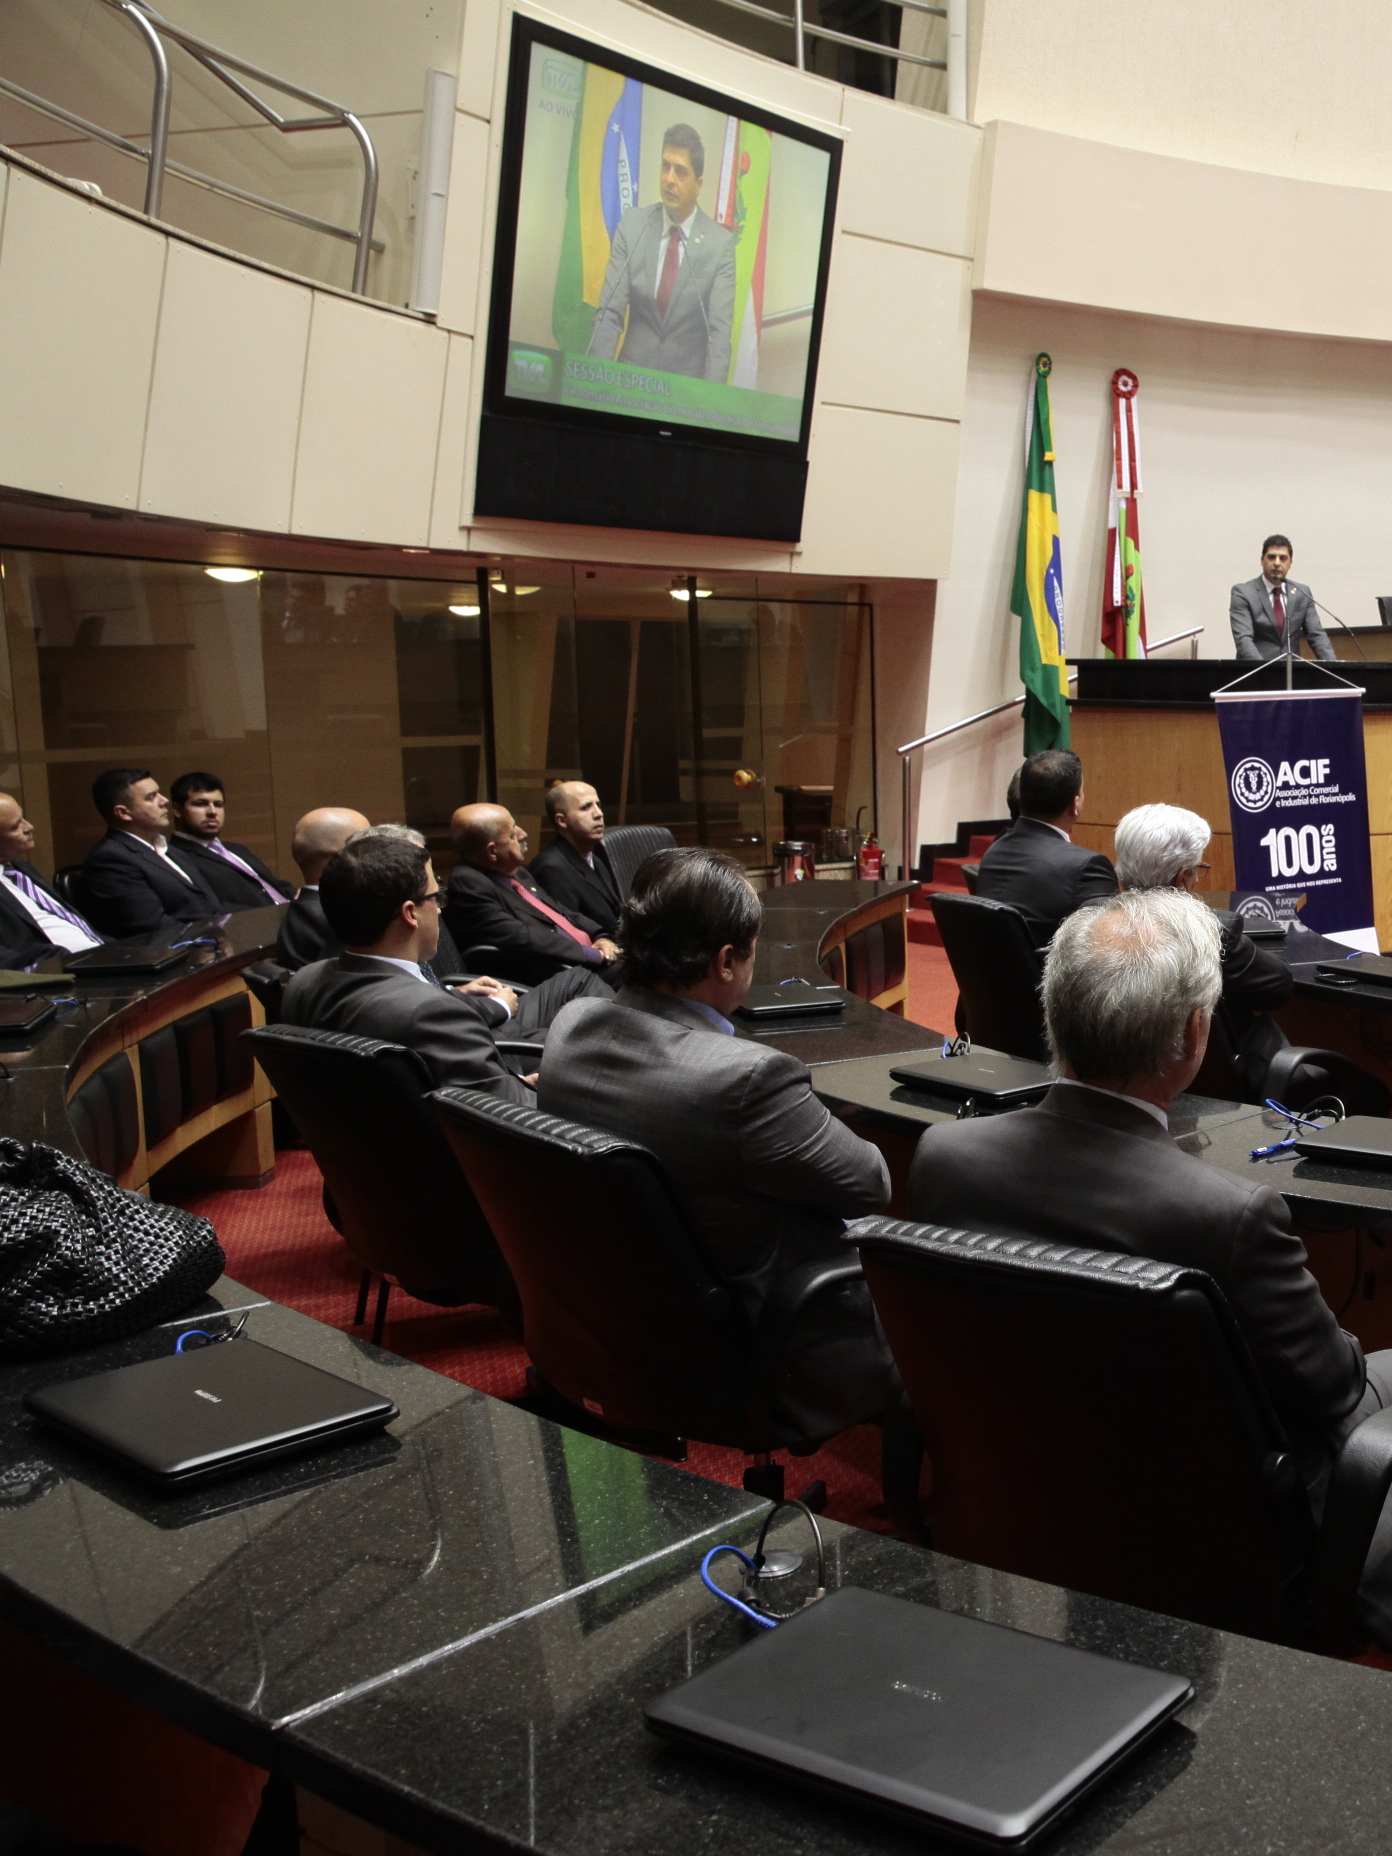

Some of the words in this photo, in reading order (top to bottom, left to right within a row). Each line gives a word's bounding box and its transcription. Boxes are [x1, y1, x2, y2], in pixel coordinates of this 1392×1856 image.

[538, 99, 554, 113] AO
[565, 360, 615, 385] SESSÃO
[617, 371, 671, 396] ESPECIAL
[1276, 758, 1330, 787] ACIF
[1275, 786, 1309, 798] Associação
[1309, 784, 1339, 795] Comercial
[1275, 800, 1281, 808] e
[1281, 796, 1309, 807] Industrial
[1310, 795, 1319, 805] de
[1319, 792, 1356, 804] Florianópolis
[1260, 824, 1322, 878] 100
[1321, 823, 1338, 872] anos
[1315, 877, 1342, 886] REPRESENTA
